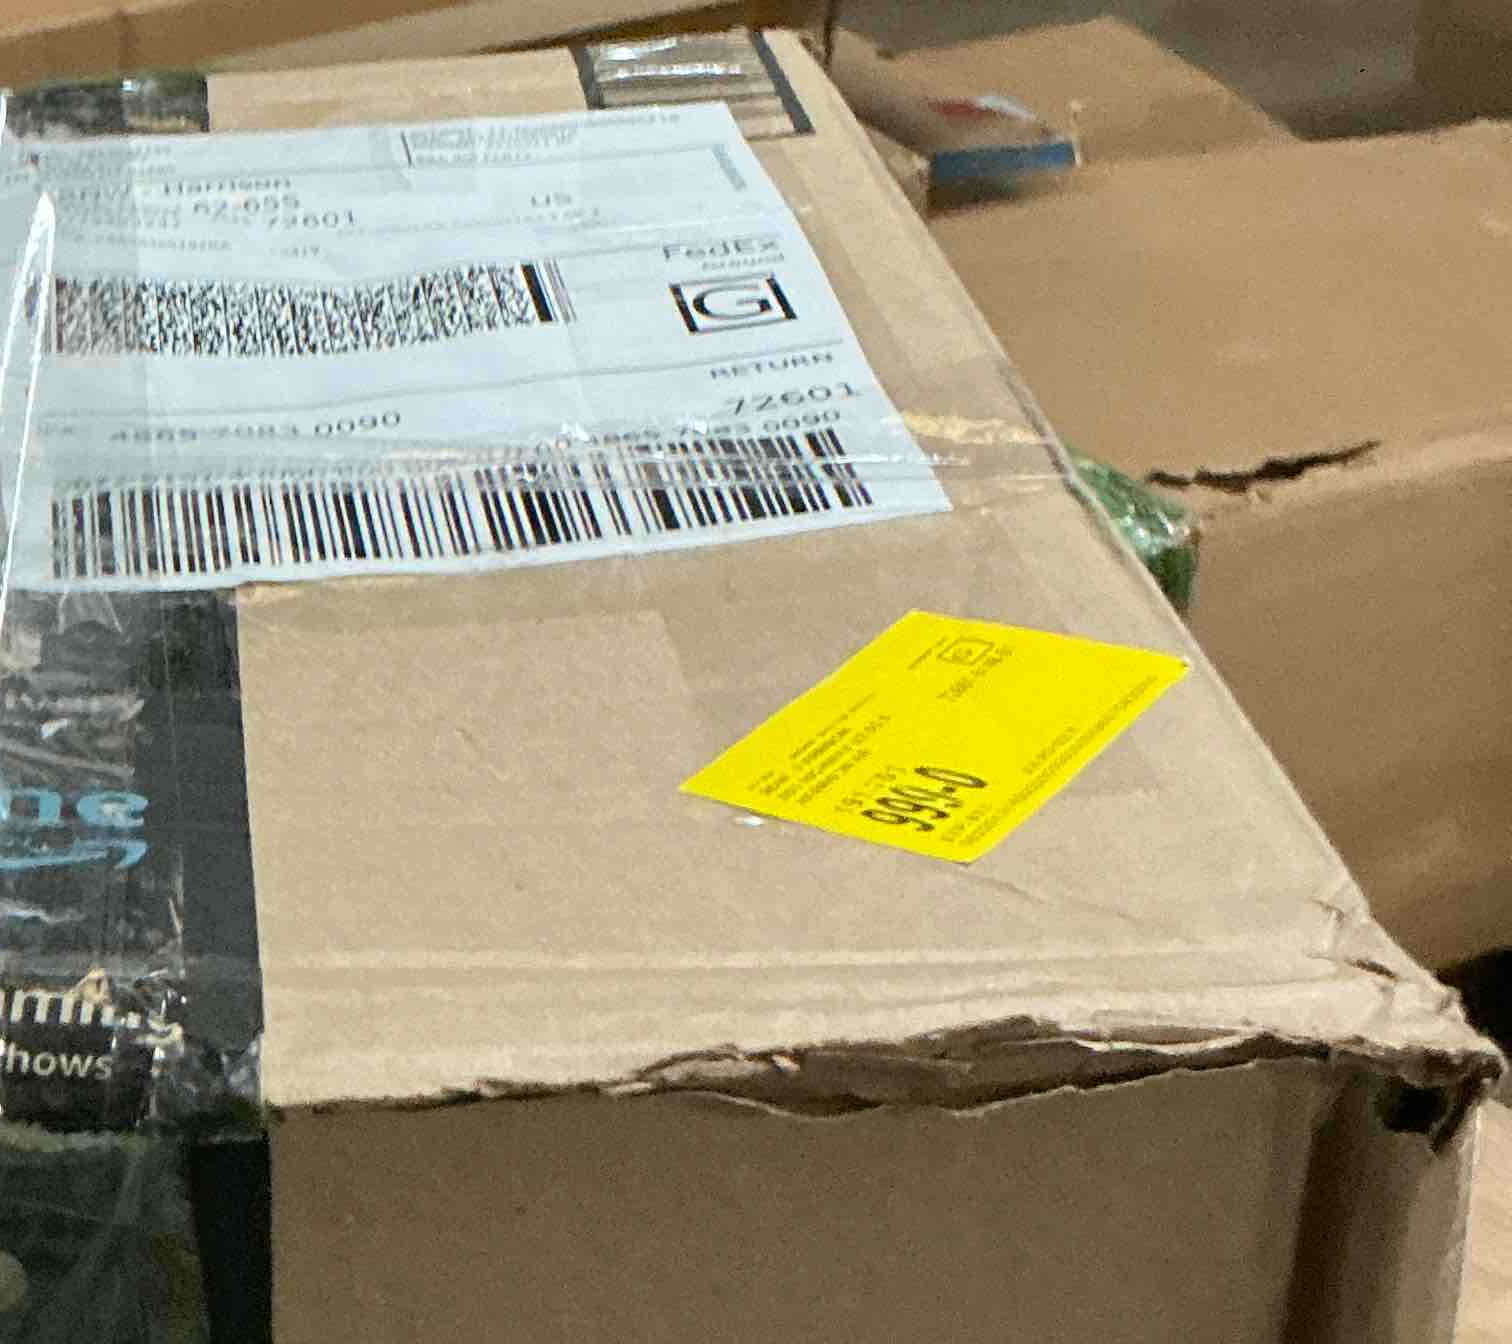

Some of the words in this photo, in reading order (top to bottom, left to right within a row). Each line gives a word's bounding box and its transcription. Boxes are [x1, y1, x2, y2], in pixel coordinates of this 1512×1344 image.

[662, 238, 781, 261] FedEx
[709, 351, 835, 381] RETURN
[725, 382, 861, 416] 72601
[313, 411, 402, 438] 0090
